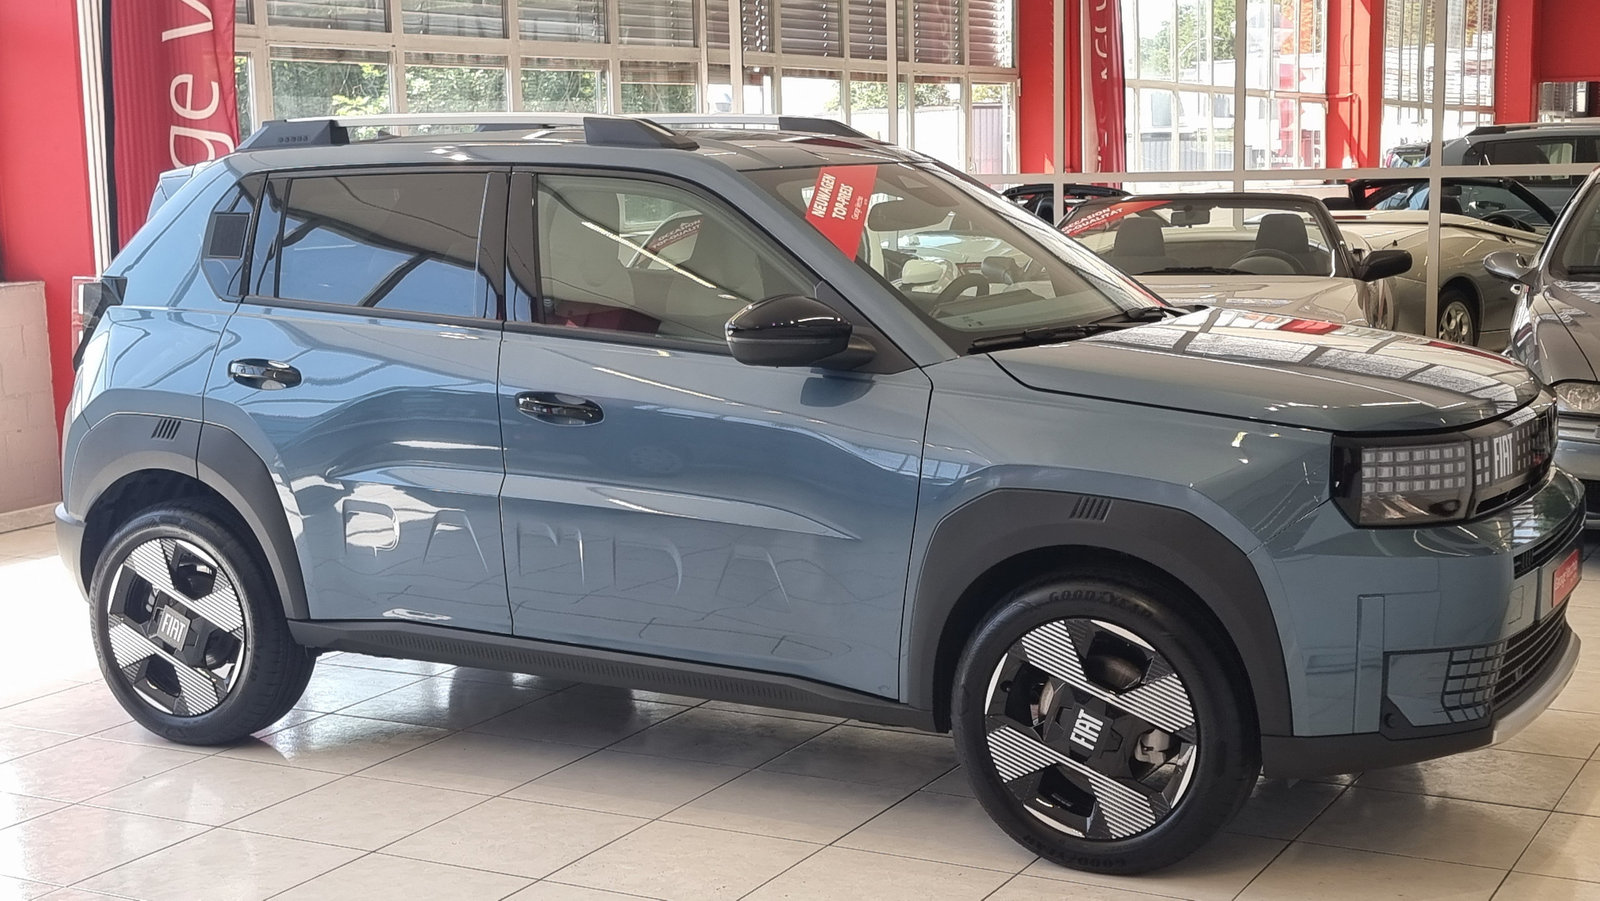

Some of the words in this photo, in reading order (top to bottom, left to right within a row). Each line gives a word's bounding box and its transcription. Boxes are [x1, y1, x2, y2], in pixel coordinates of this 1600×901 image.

[811, 172, 836, 218] NEUWAGEN
[832, 183, 854, 220] TOP-PREIS
[1061, 207, 1111, 232] OCCASION
[1493, 433, 1513, 479] FIAT
[343, 497, 790, 612] PANDA
[1048, 589, 1154, 618] GOODYEAR
[161, 612, 186, 643] FIAT
[1070, 708, 1104, 750] FIAT
